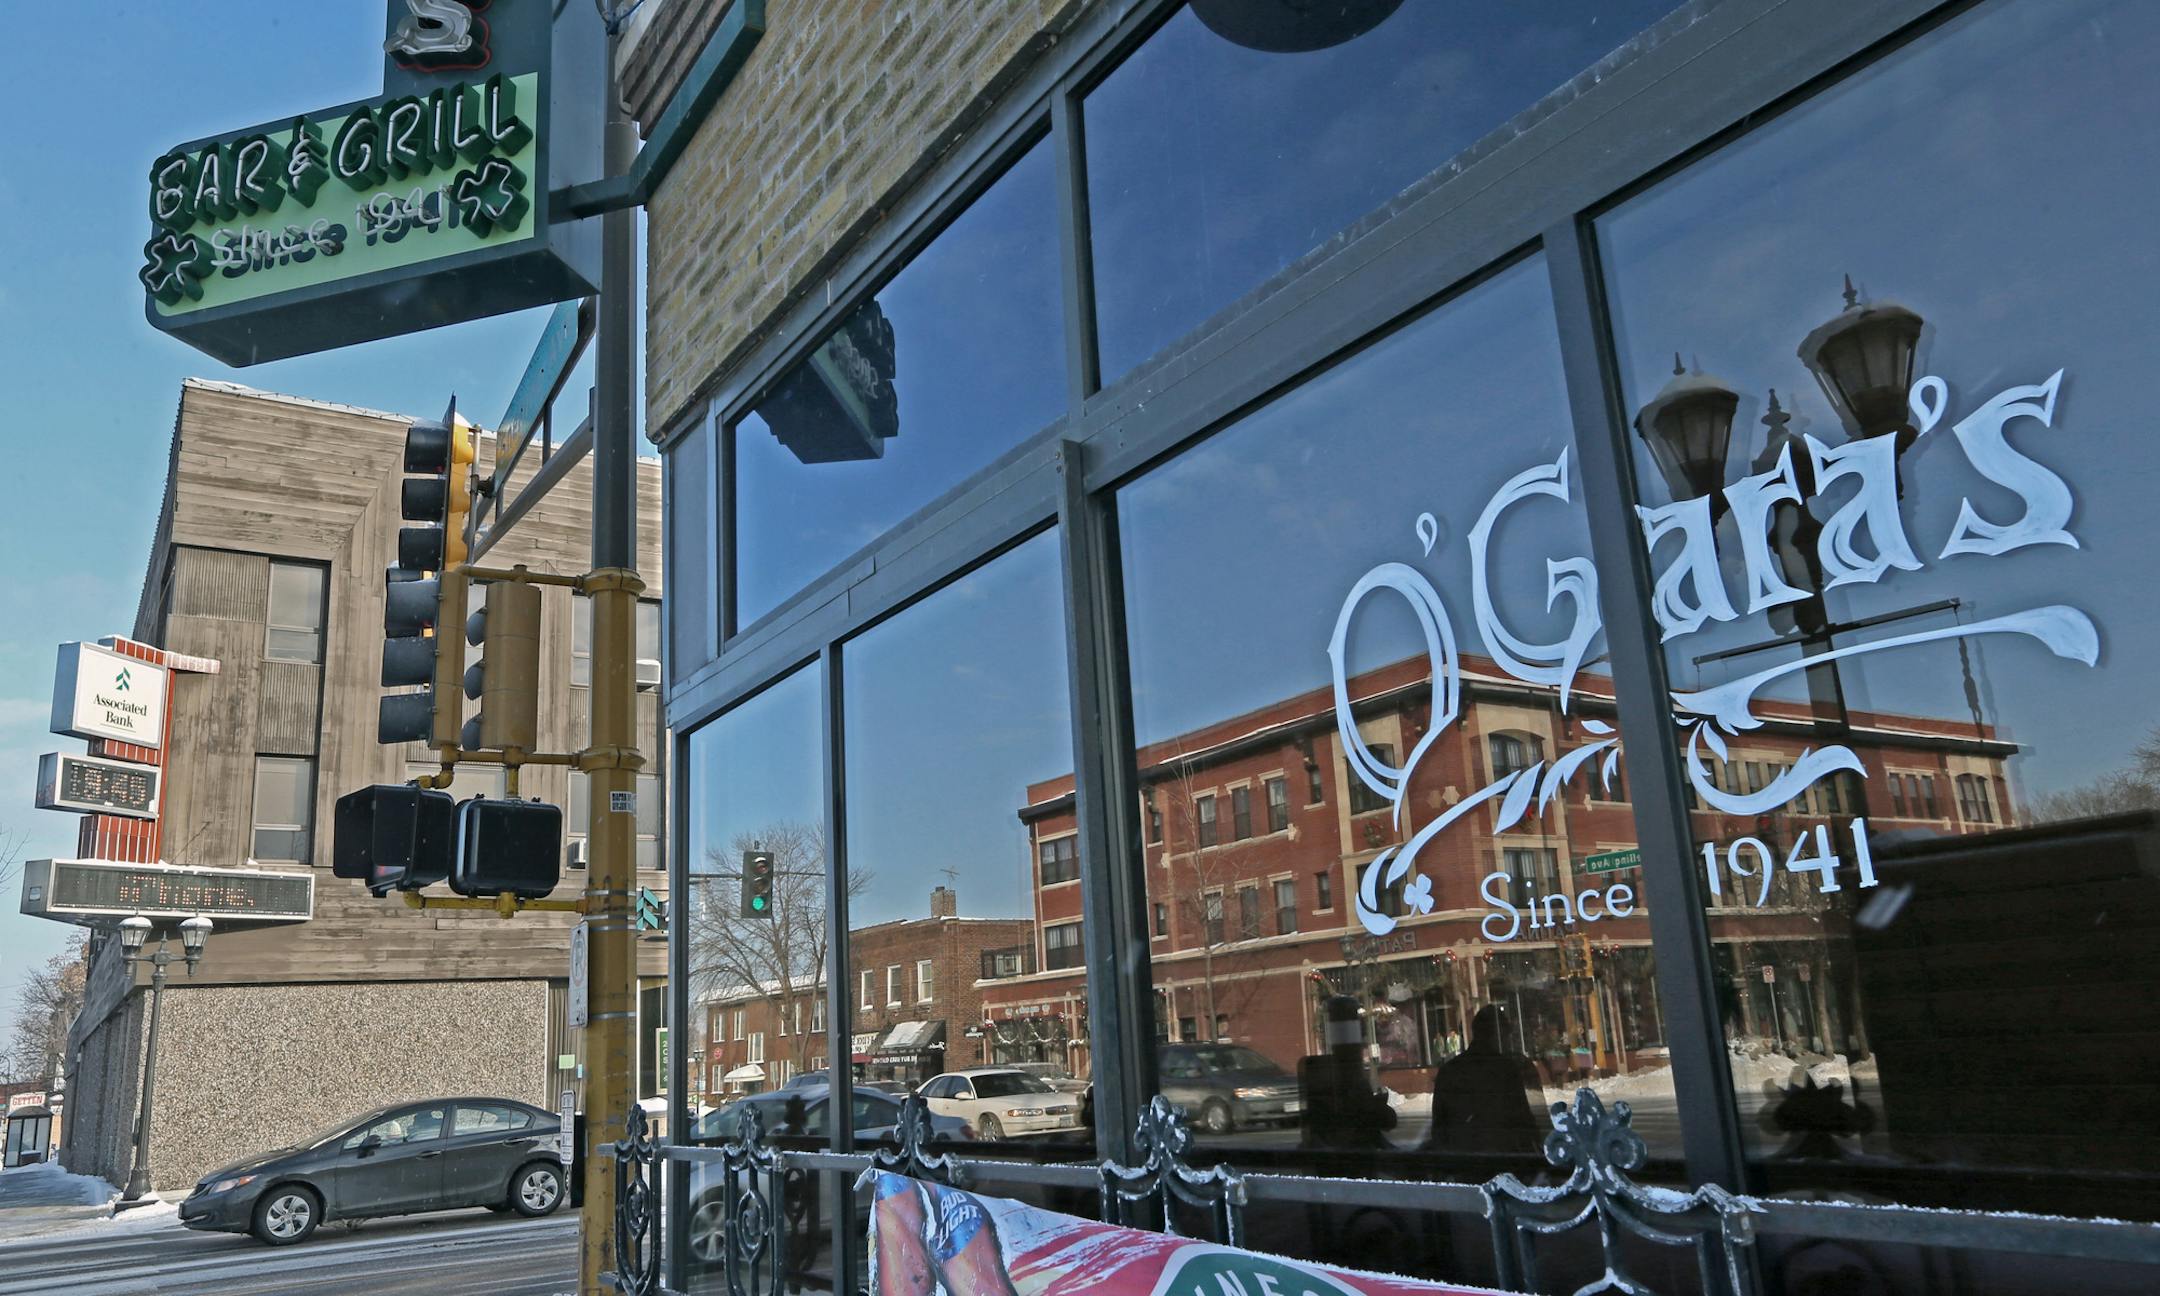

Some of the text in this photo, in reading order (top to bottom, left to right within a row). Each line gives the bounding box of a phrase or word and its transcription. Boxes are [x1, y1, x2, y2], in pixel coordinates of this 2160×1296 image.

[152, 134, 286, 232] BAR
[331, 73, 533, 192] GRILL
[355, 184, 460, 247] 1941
[93, 693, 148, 717] Associated
[105, 710, 134, 728] Bank
[1479, 816, 1880, 942] Since 1941
[940, 1191, 967, 1223] BUD
